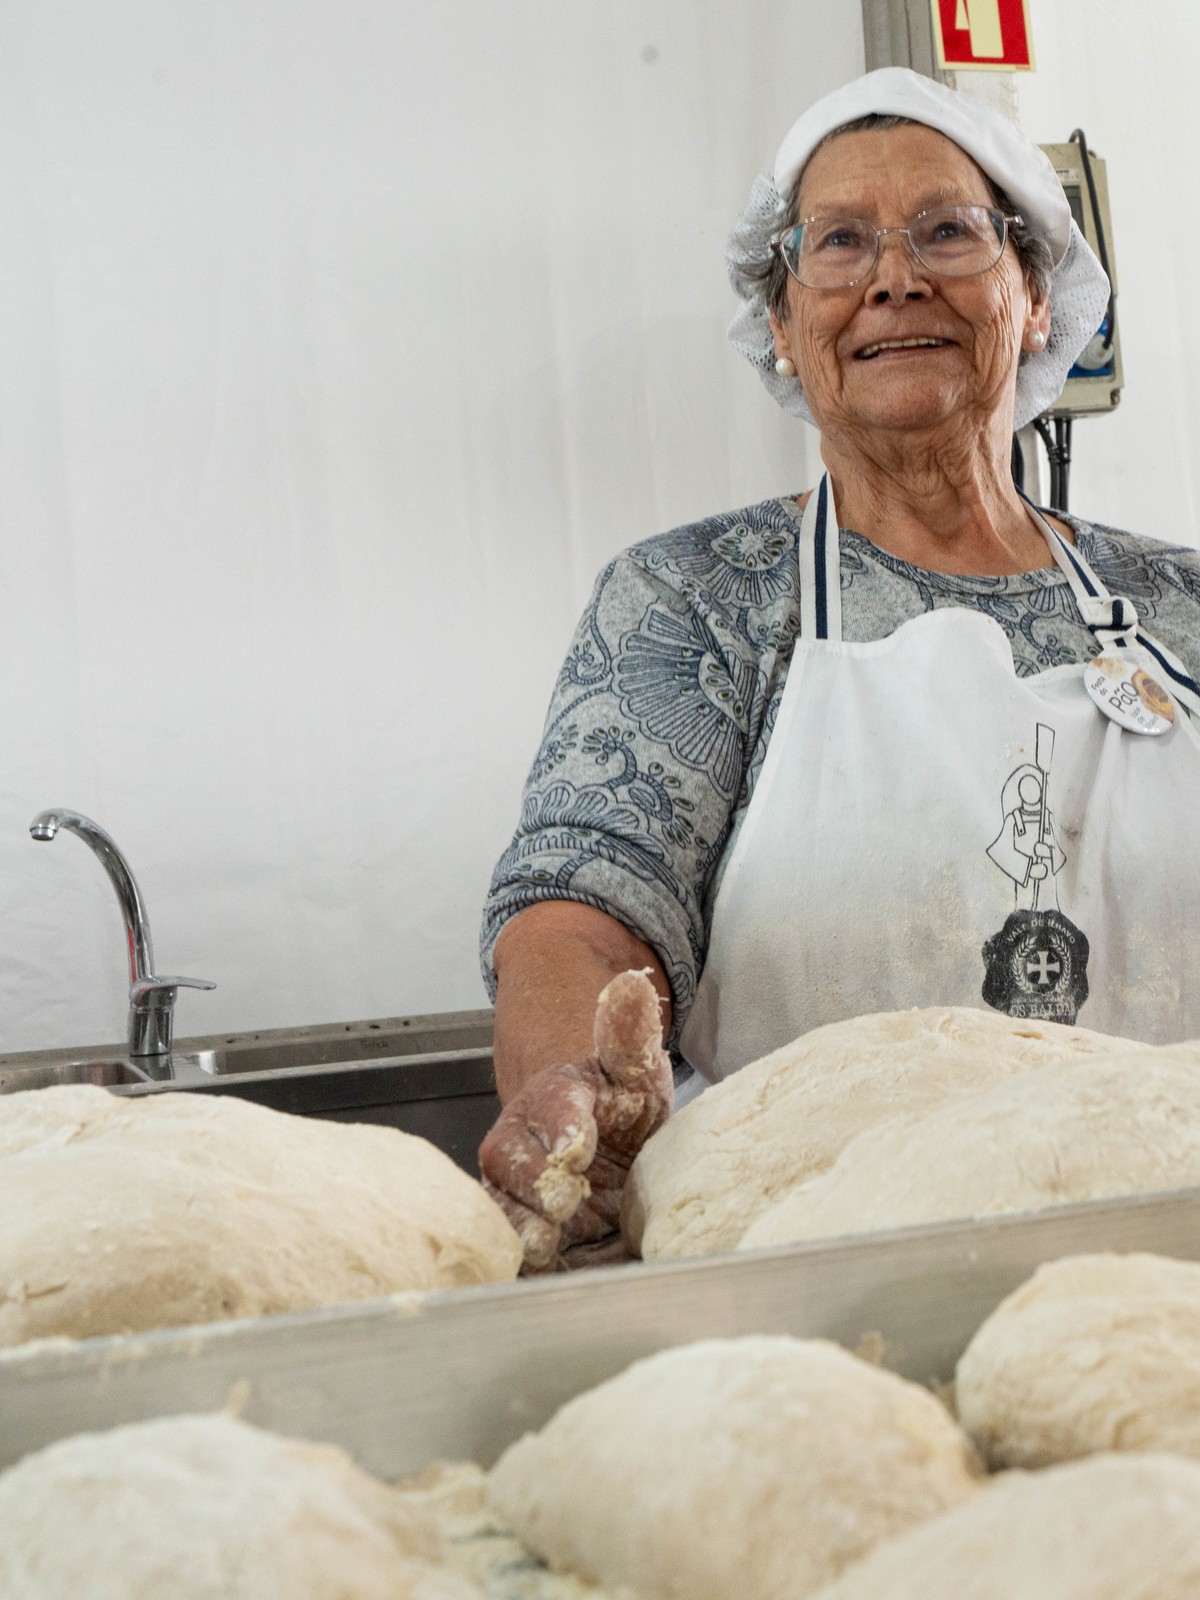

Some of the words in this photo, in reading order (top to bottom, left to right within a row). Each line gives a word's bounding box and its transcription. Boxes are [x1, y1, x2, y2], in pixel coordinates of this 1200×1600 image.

[1006, 922, 1028, 942] VALE
[1031, 918, 1045, 927] DE
[1010, 1004, 1026, 1017] OS
